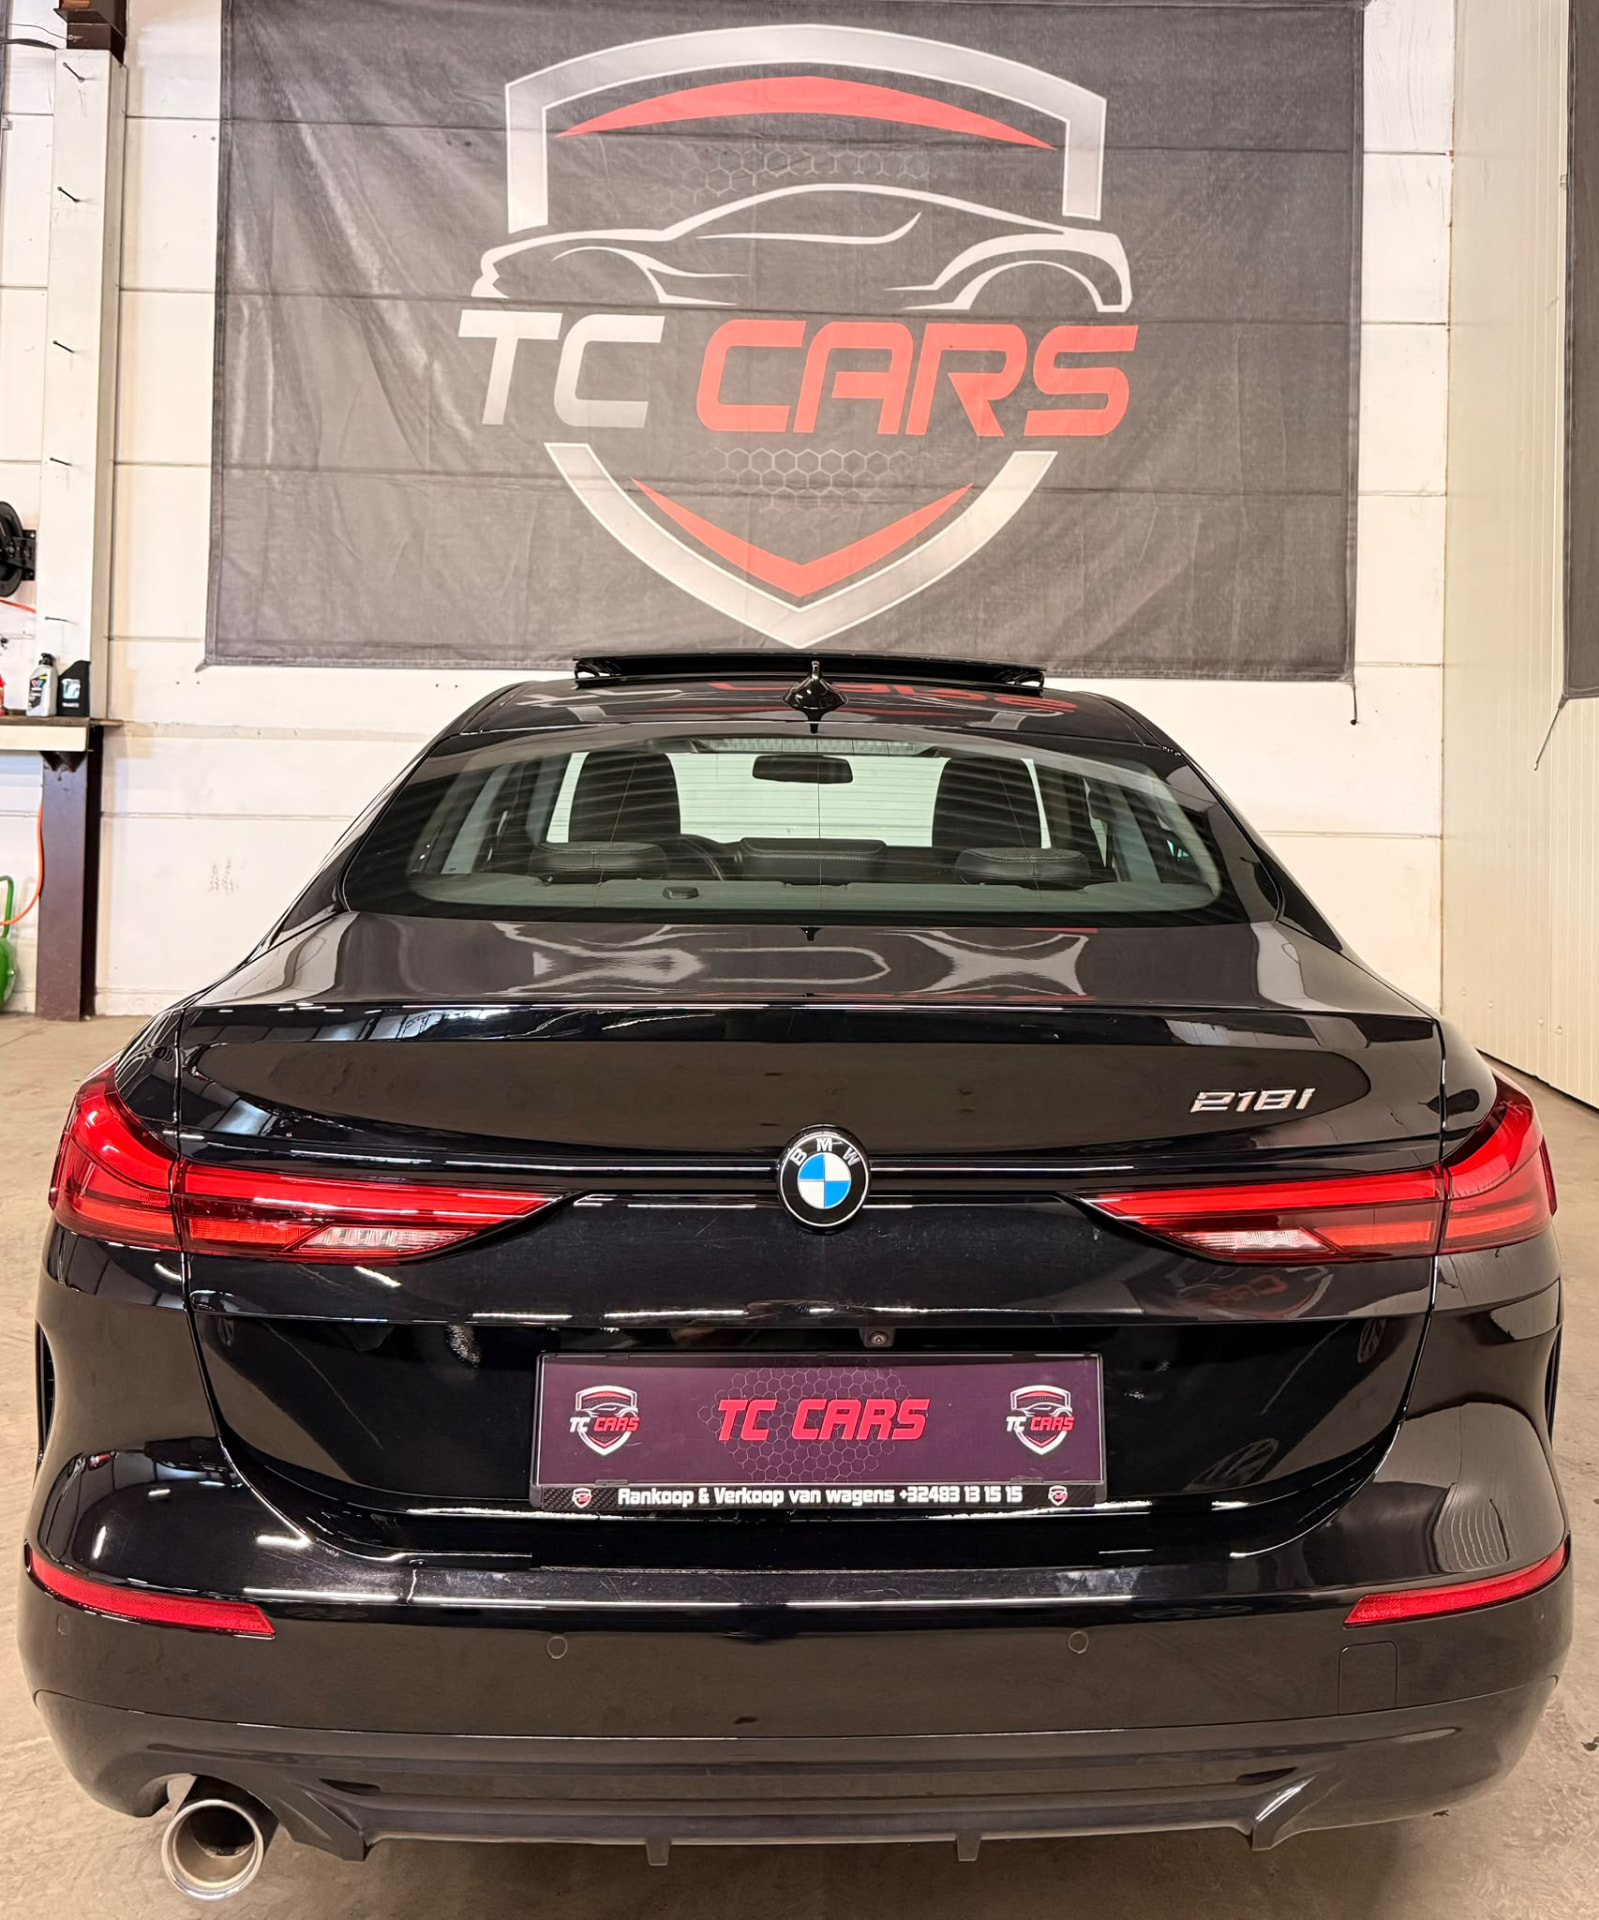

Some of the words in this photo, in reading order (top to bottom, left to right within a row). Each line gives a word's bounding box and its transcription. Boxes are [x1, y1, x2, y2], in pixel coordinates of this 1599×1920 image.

[458, 309, 665, 428] TC
[696, 319, 1139, 437] CARS
[789, 1137, 860, 1167] BMW
[569, 1416, 591, 1433] TC
[593, 1416, 640, 1432] CARS
[718, 1398, 778, 1441] TC
[791, 1398, 930, 1441] CARS
[1006, 1416, 1027, 1432] TC
[1030, 1416, 1075, 1431] CARS
[698, 1487, 710, 1504] &
[713, 1487, 784, 1507] Verkoop
[788, 1488, 821, 1504] van
[825, 1488, 895, 1506] wagens
[899, 1485, 960, 1503] +32483
[964, 1485, 981, 1503] 13
[984, 1485, 1002, 1503] 15
[1005, 1485, 1023, 1502] 15
